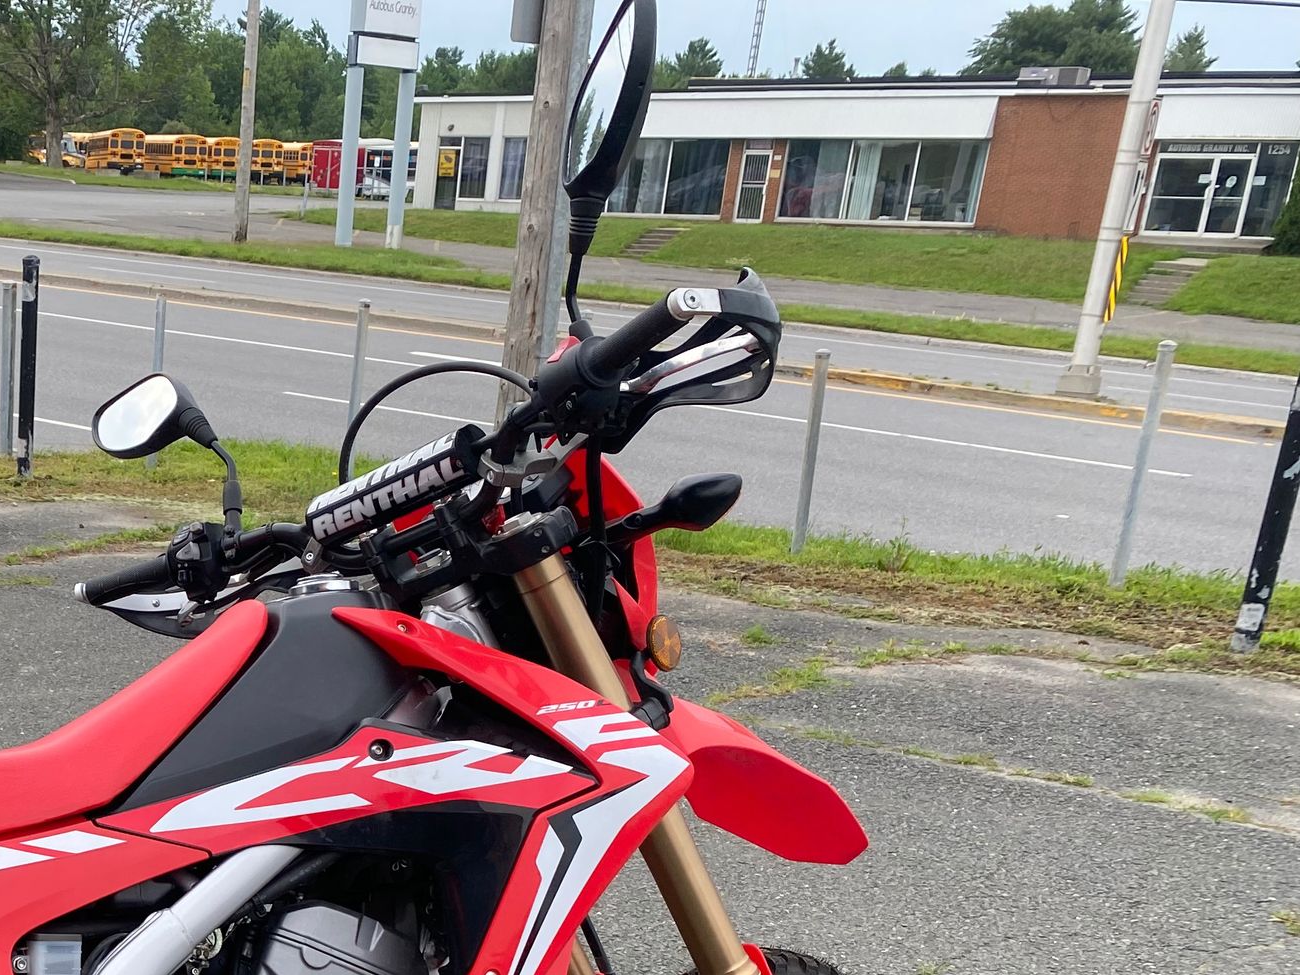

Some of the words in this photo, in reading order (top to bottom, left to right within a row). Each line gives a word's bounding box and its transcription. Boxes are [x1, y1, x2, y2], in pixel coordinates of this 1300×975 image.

[369, 0, 394, 12] Autobus
[395, 1, 417, 18] Granby
[1167, 143, 1201, 152] AUTOBUS
[1202, 144, 1234, 152] GRANBY
[1234, 144, 1250, 152] INC.
[1267, 145, 1291, 155] 1254
[312, 456, 465, 540] RENTHAL
